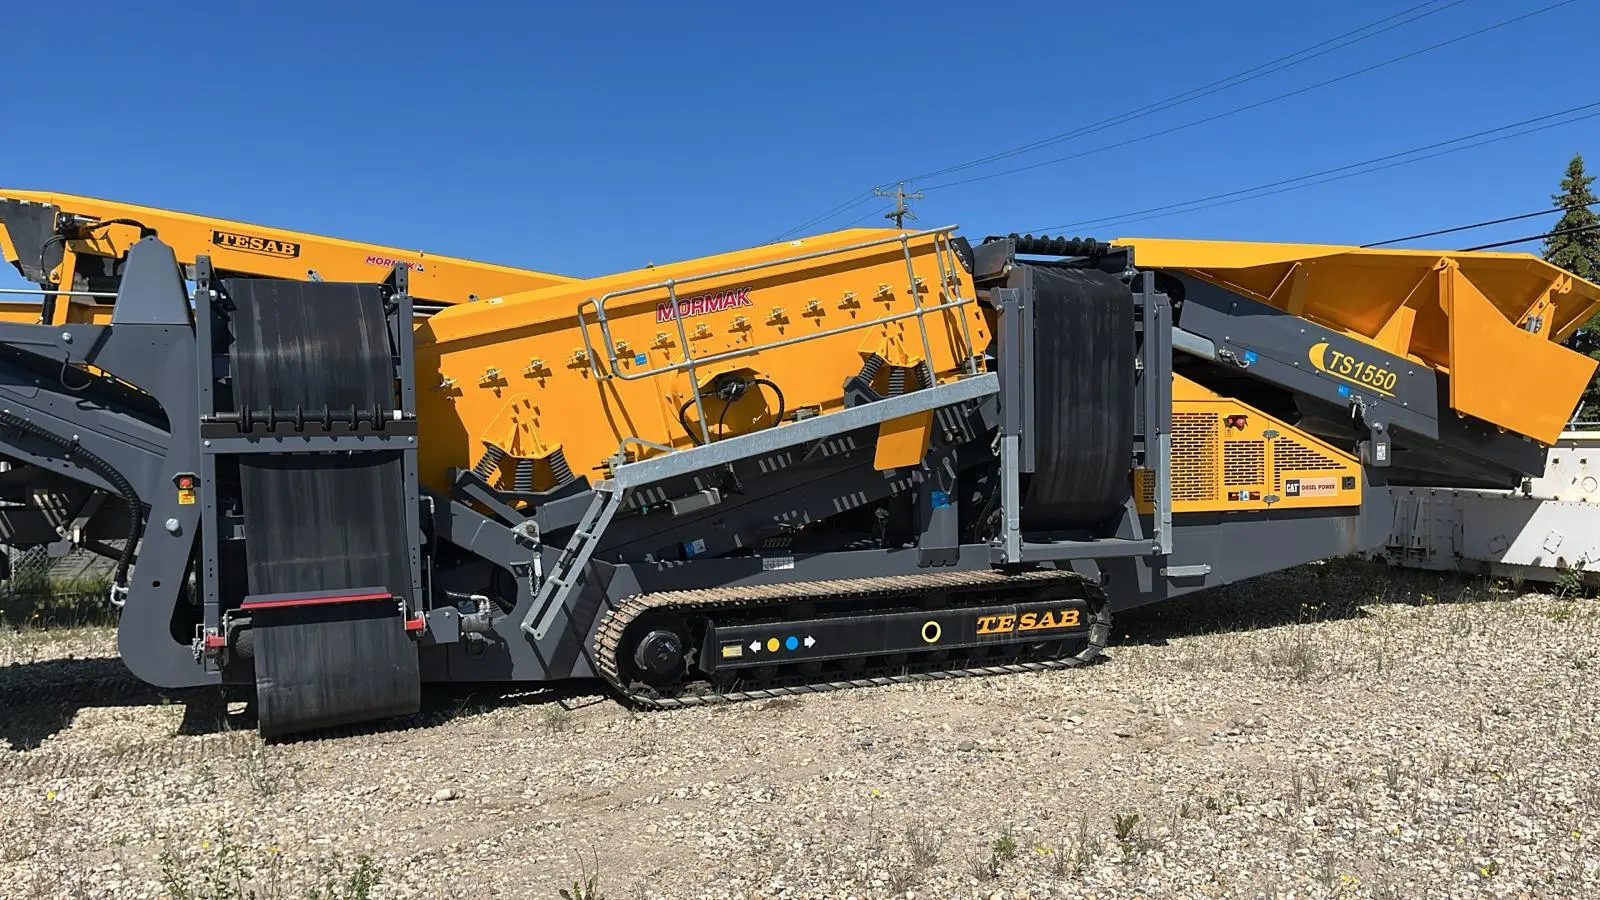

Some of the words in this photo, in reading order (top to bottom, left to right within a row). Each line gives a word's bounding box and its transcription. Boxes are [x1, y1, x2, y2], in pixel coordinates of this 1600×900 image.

[218, 232, 295, 255] TESAB
[365, 256, 414, 270] MORK
[656, 287, 752, 324] MORMAK
[1330, 350, 1397, 390] TS1550
[1286, 483, 1299, 493] CAT
[976, 609, 1081, 635] TESAB
